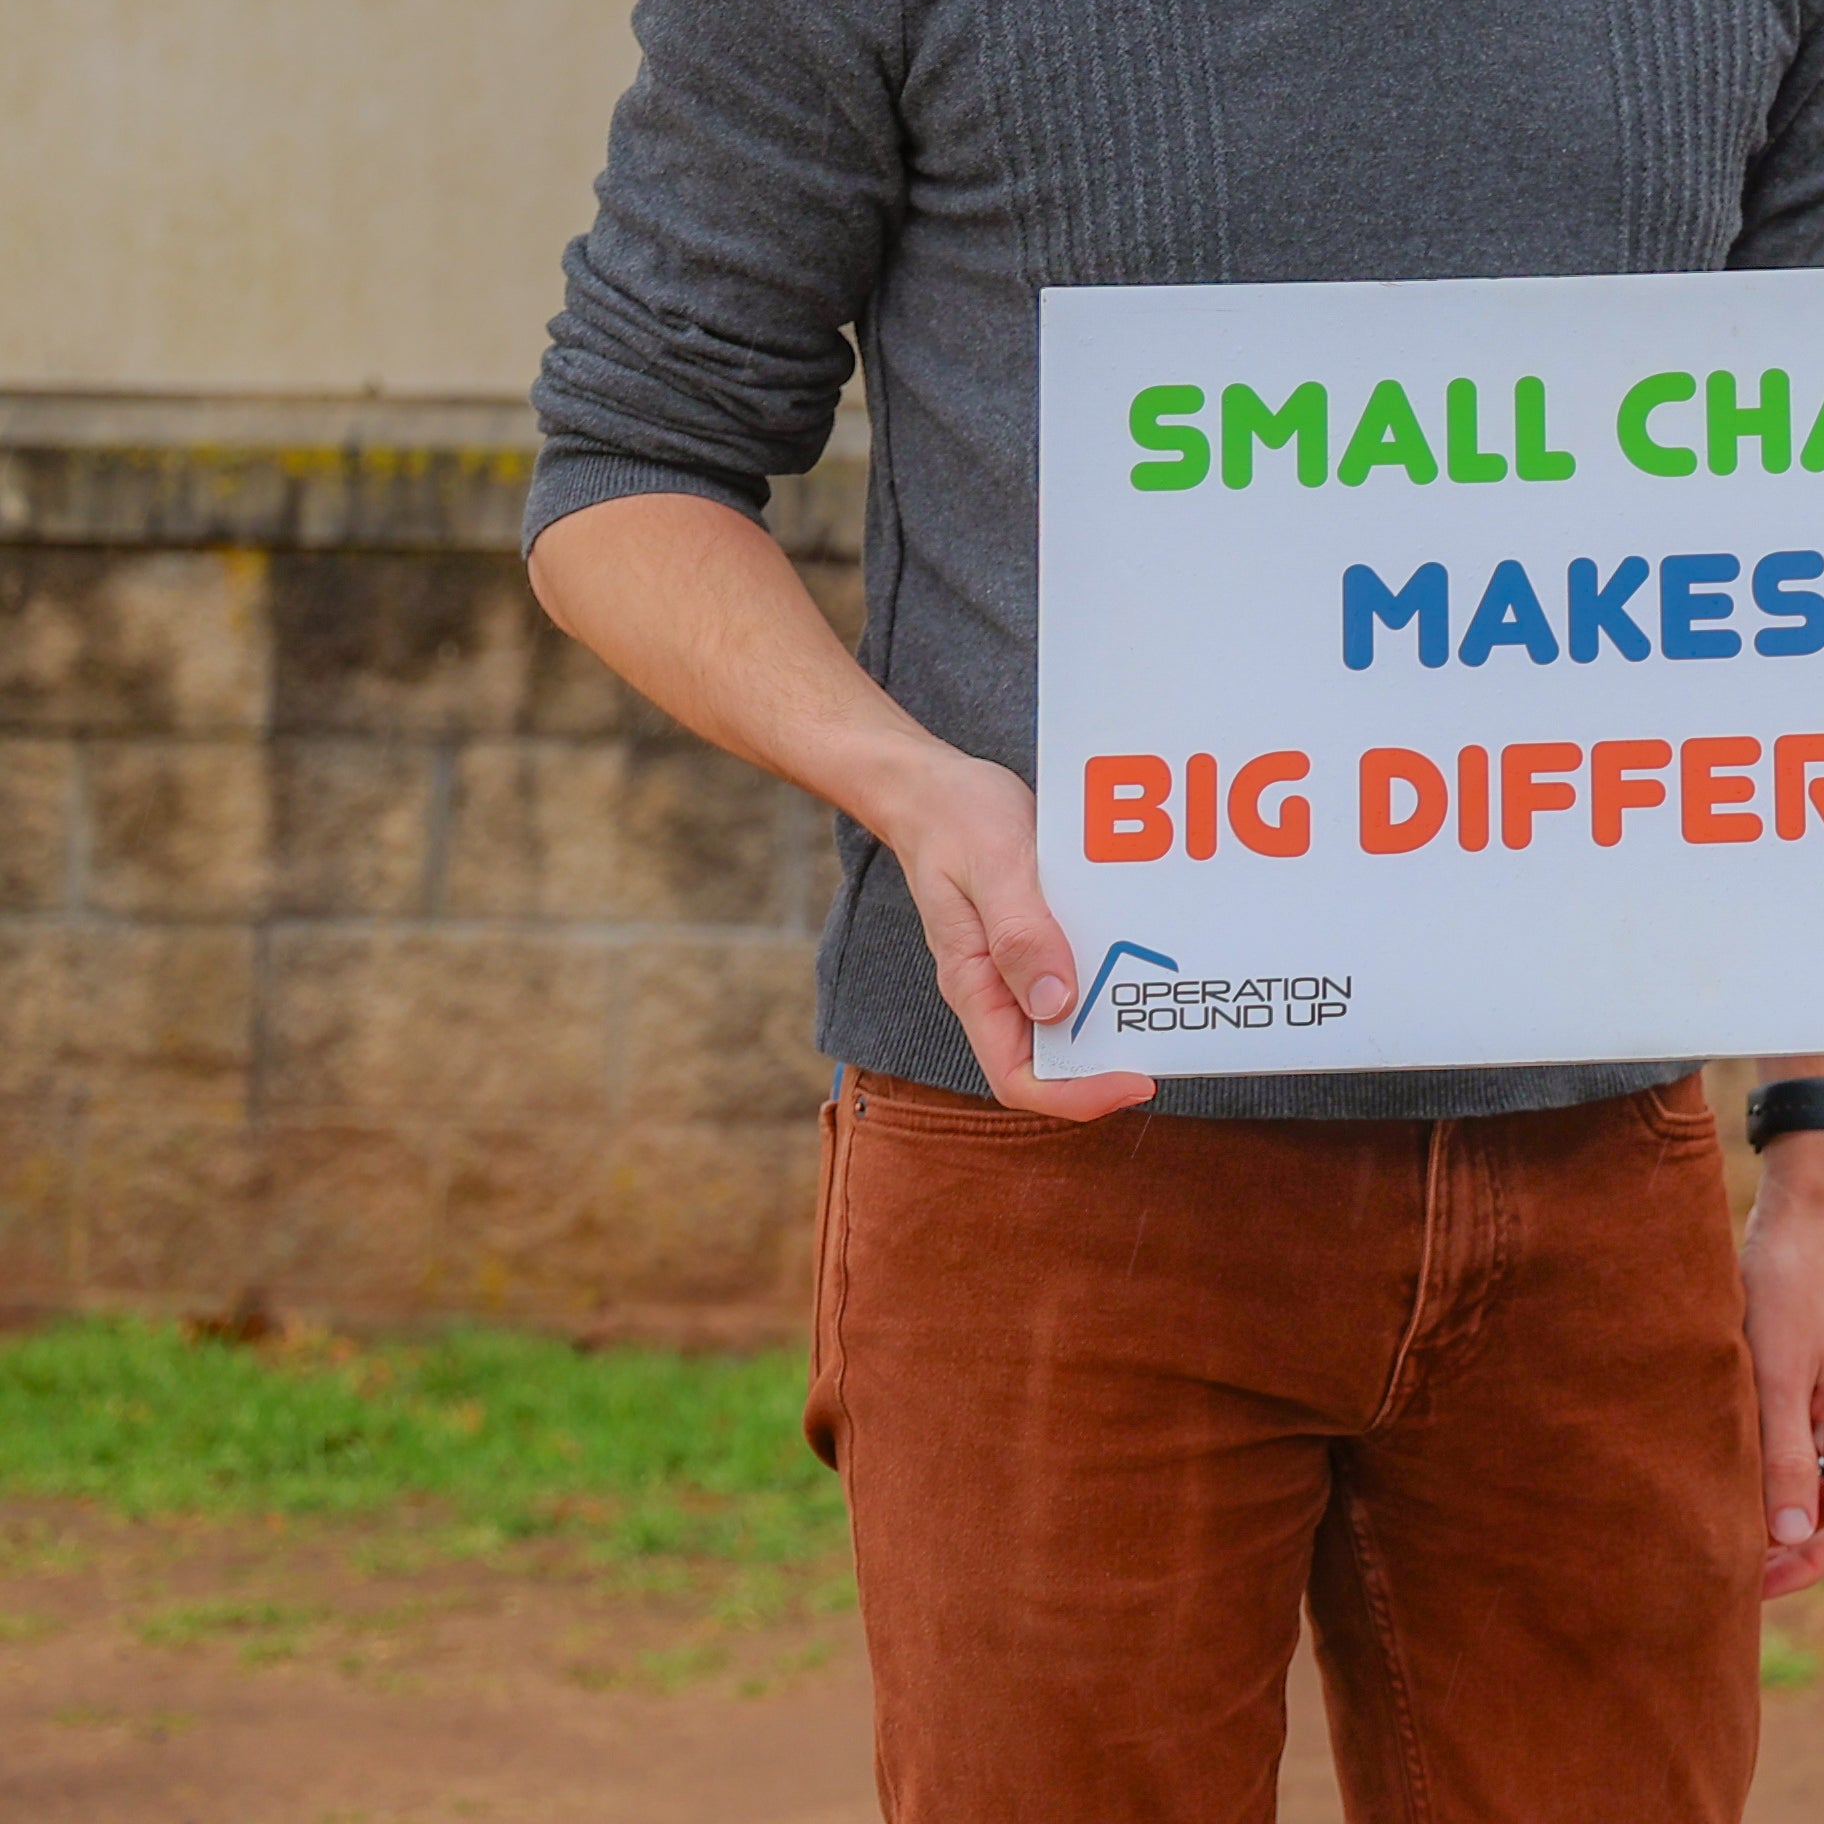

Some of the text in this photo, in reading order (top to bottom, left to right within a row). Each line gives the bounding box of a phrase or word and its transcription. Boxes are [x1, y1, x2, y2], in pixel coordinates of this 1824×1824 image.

[1128, 374, 1577, 493] SMALL
[1082, 748, 1312, 865] BIG
[1110, 974, 1353, 1008] OPERATION
[1115, 1000, 1348, 1034] ROUND UP
